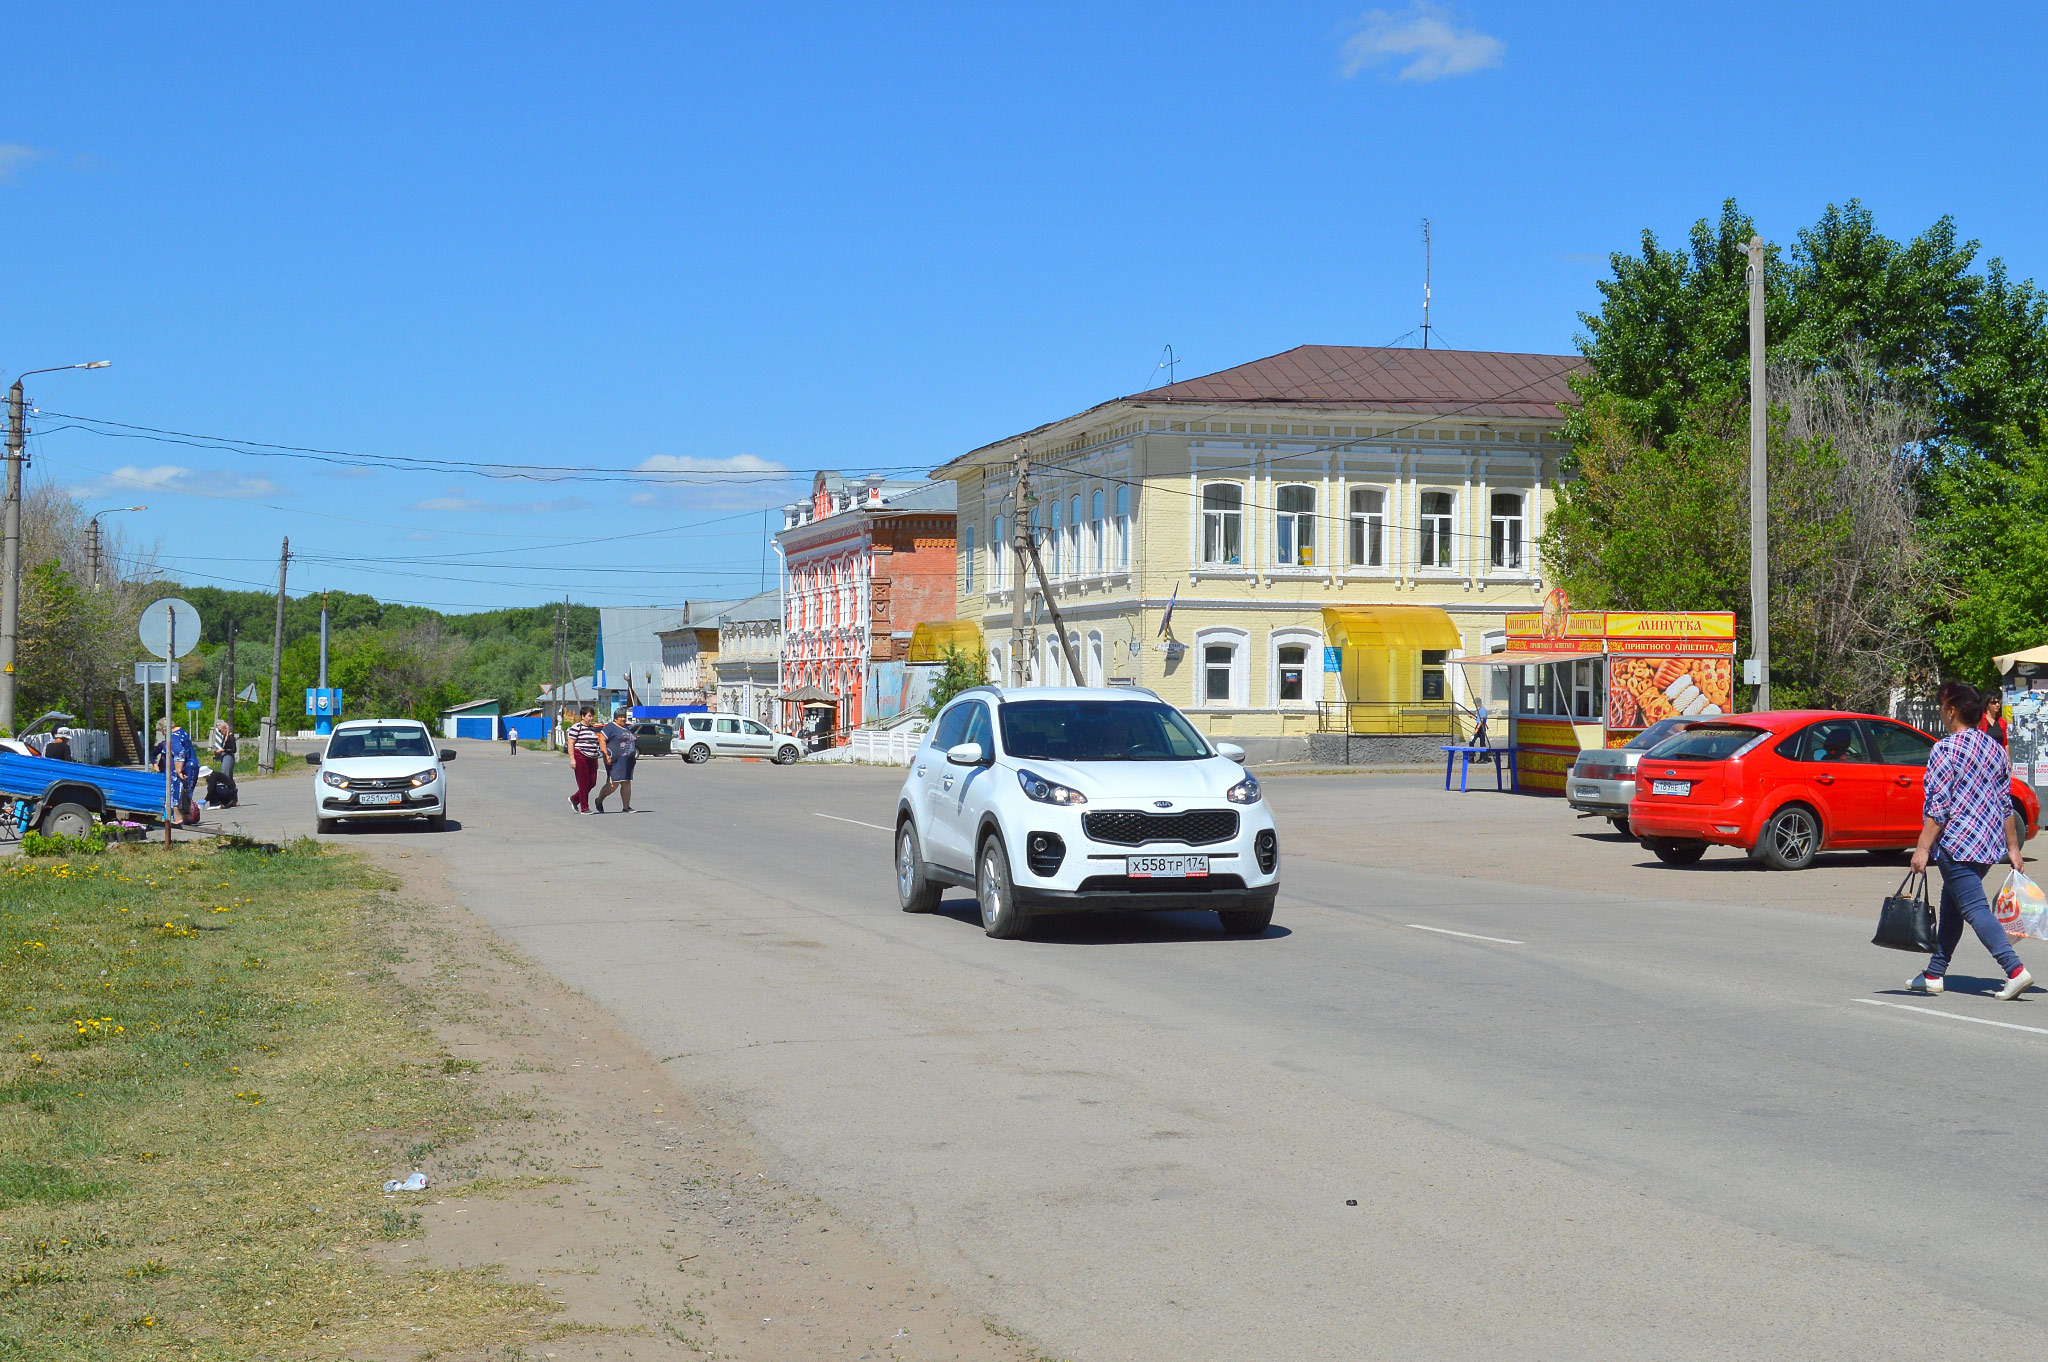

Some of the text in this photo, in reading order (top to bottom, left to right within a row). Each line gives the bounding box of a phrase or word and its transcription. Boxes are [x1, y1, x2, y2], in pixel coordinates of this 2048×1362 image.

[1509, 619, 1540, 631] МИНУТКА
[1570, 619, 1602, 631] МИНУТКА
[1637, 620, 1702, 633] МИНУТКА
[1625, 643, 1715, 651] ПРИЯТНОГО АППЕТИТА
[1133, 857, 1205, 871] Х558ТР 174
